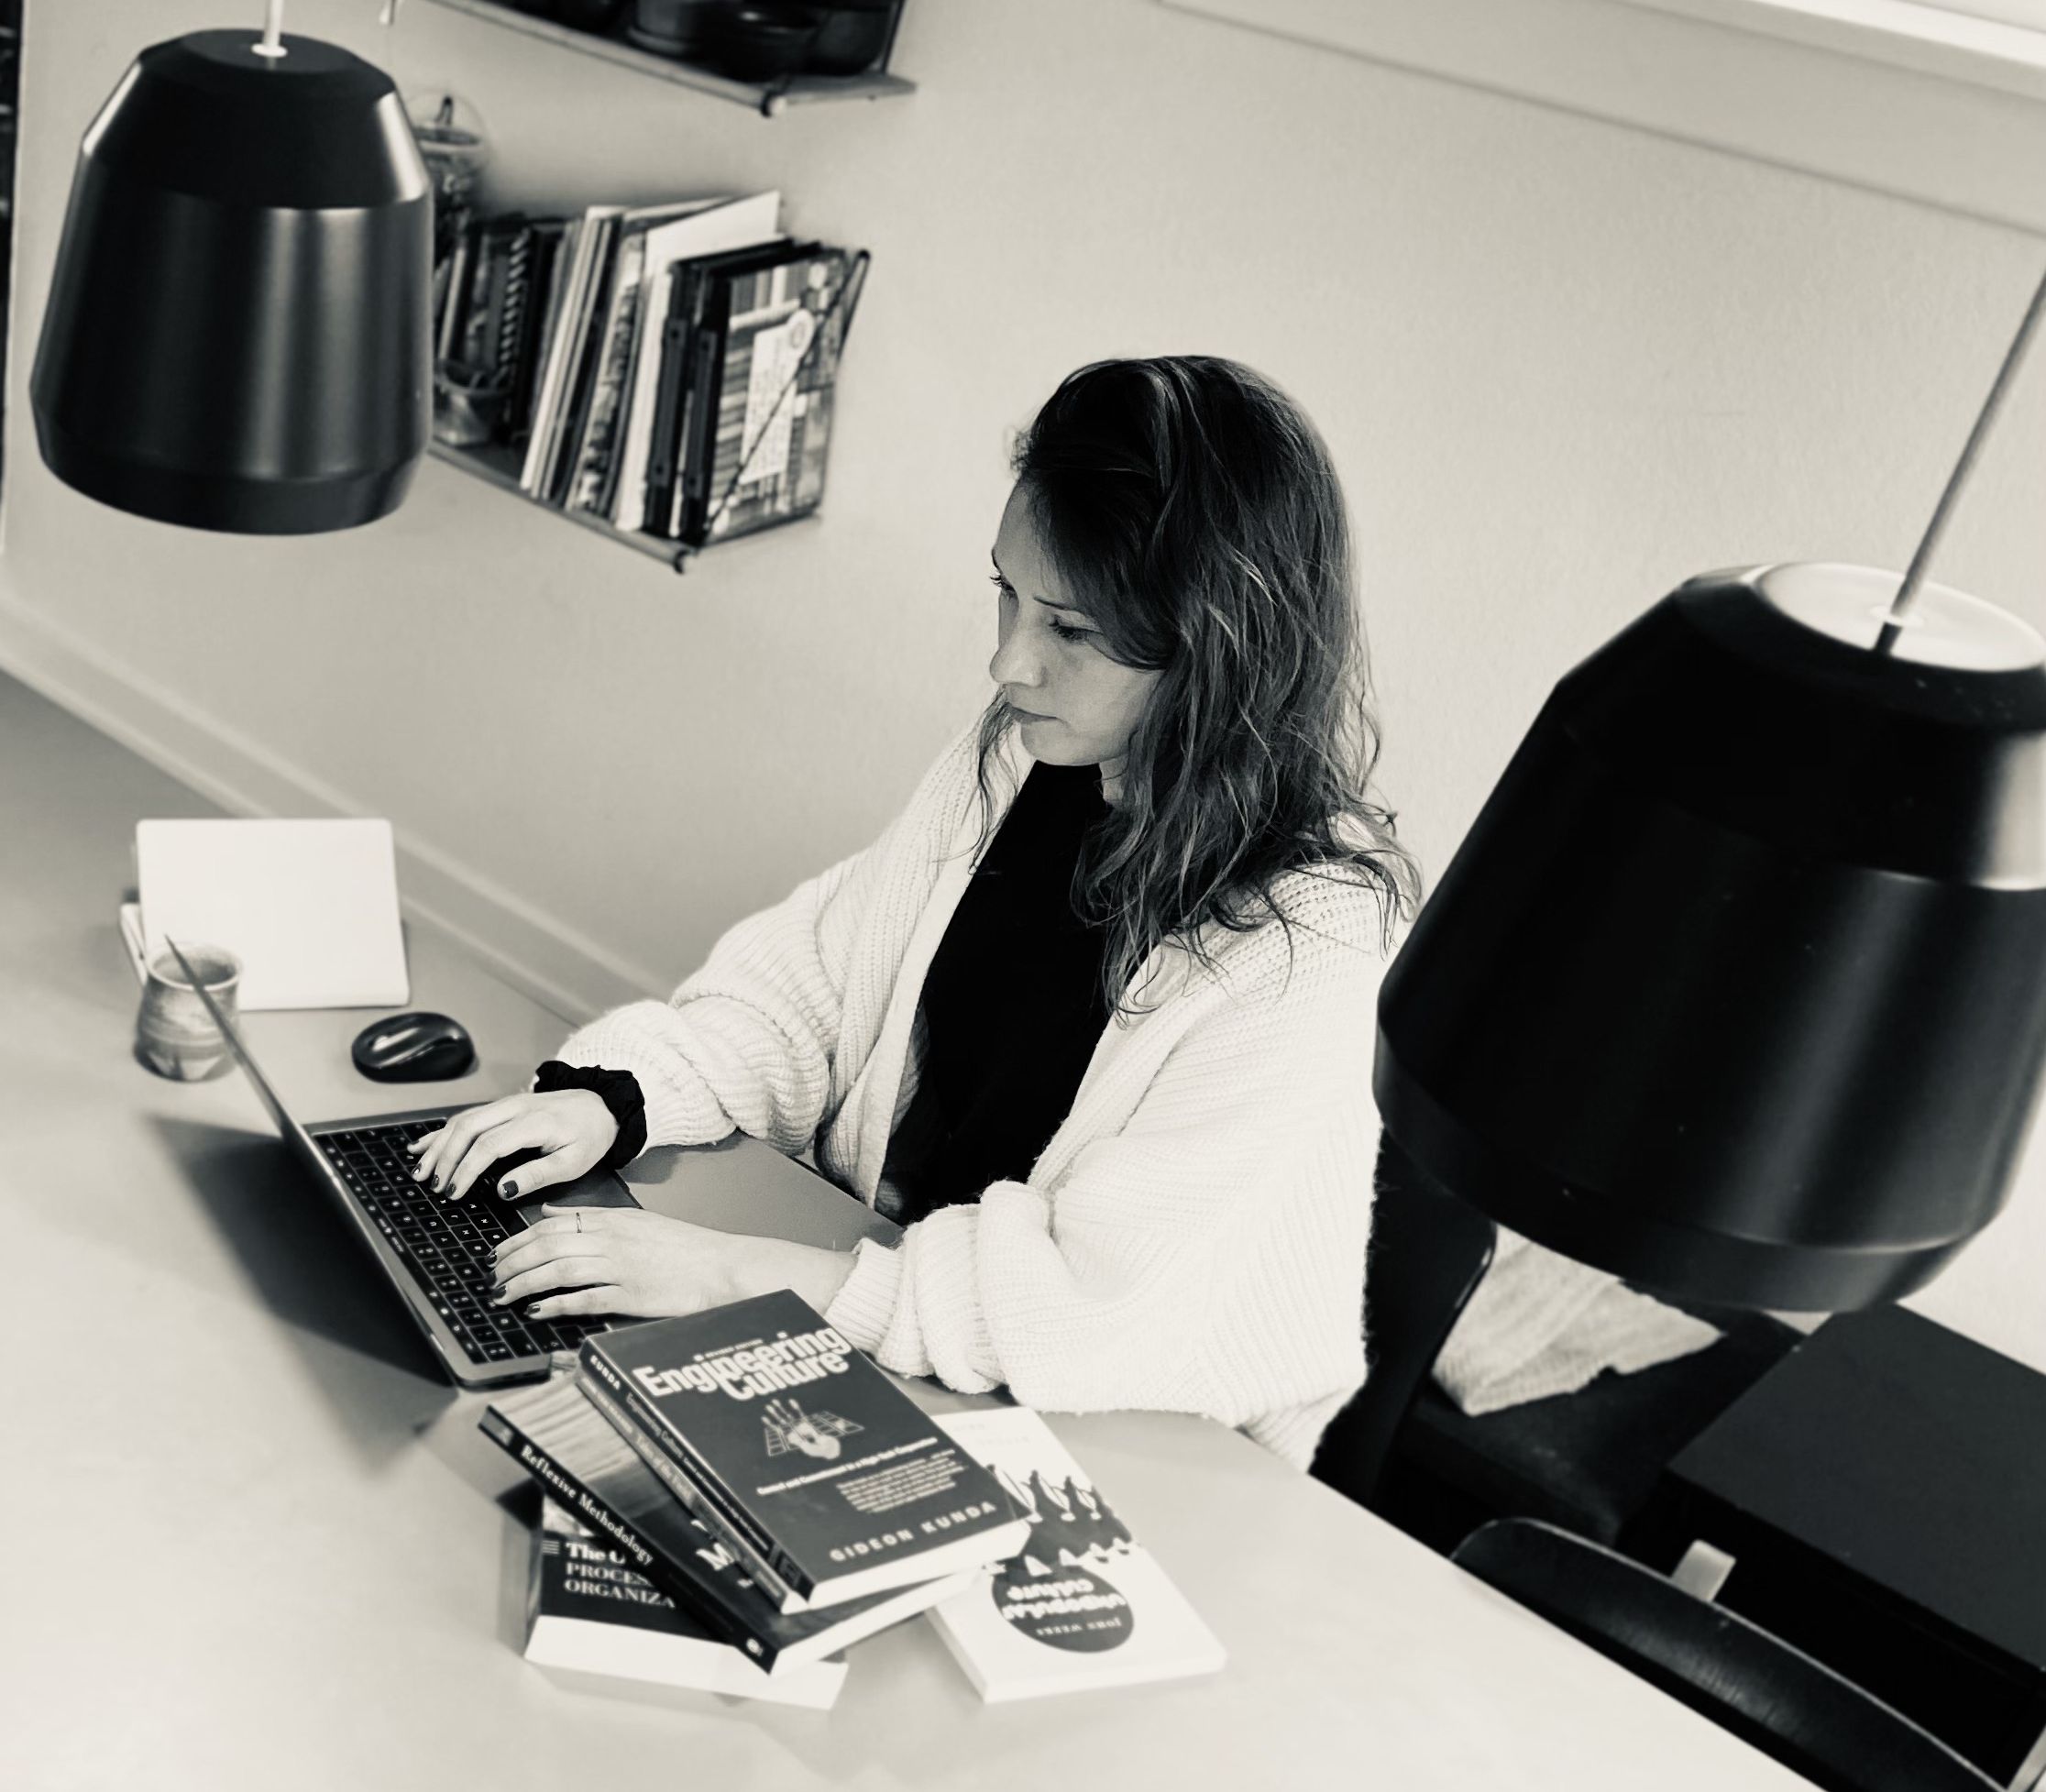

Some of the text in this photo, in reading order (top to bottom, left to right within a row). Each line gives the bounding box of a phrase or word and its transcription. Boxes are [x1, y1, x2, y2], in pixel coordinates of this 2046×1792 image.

[589, 1355, 622, 1391] KUNDA
[632, 1328, 852, 1397] Engineering
[717, 1352, 850, 1401] Culture
[521, 1445, 577, 1499] Reflexive
[578, 1492, 654, 1567] Methodology
[566, 1542, 606, 1561] The
[830, 1501, 997, 1562] GIDEON KUNDA
[564, 1579, 676, 1610] ORGANIZA
[566, 1562, 654, 1589] PROCES
